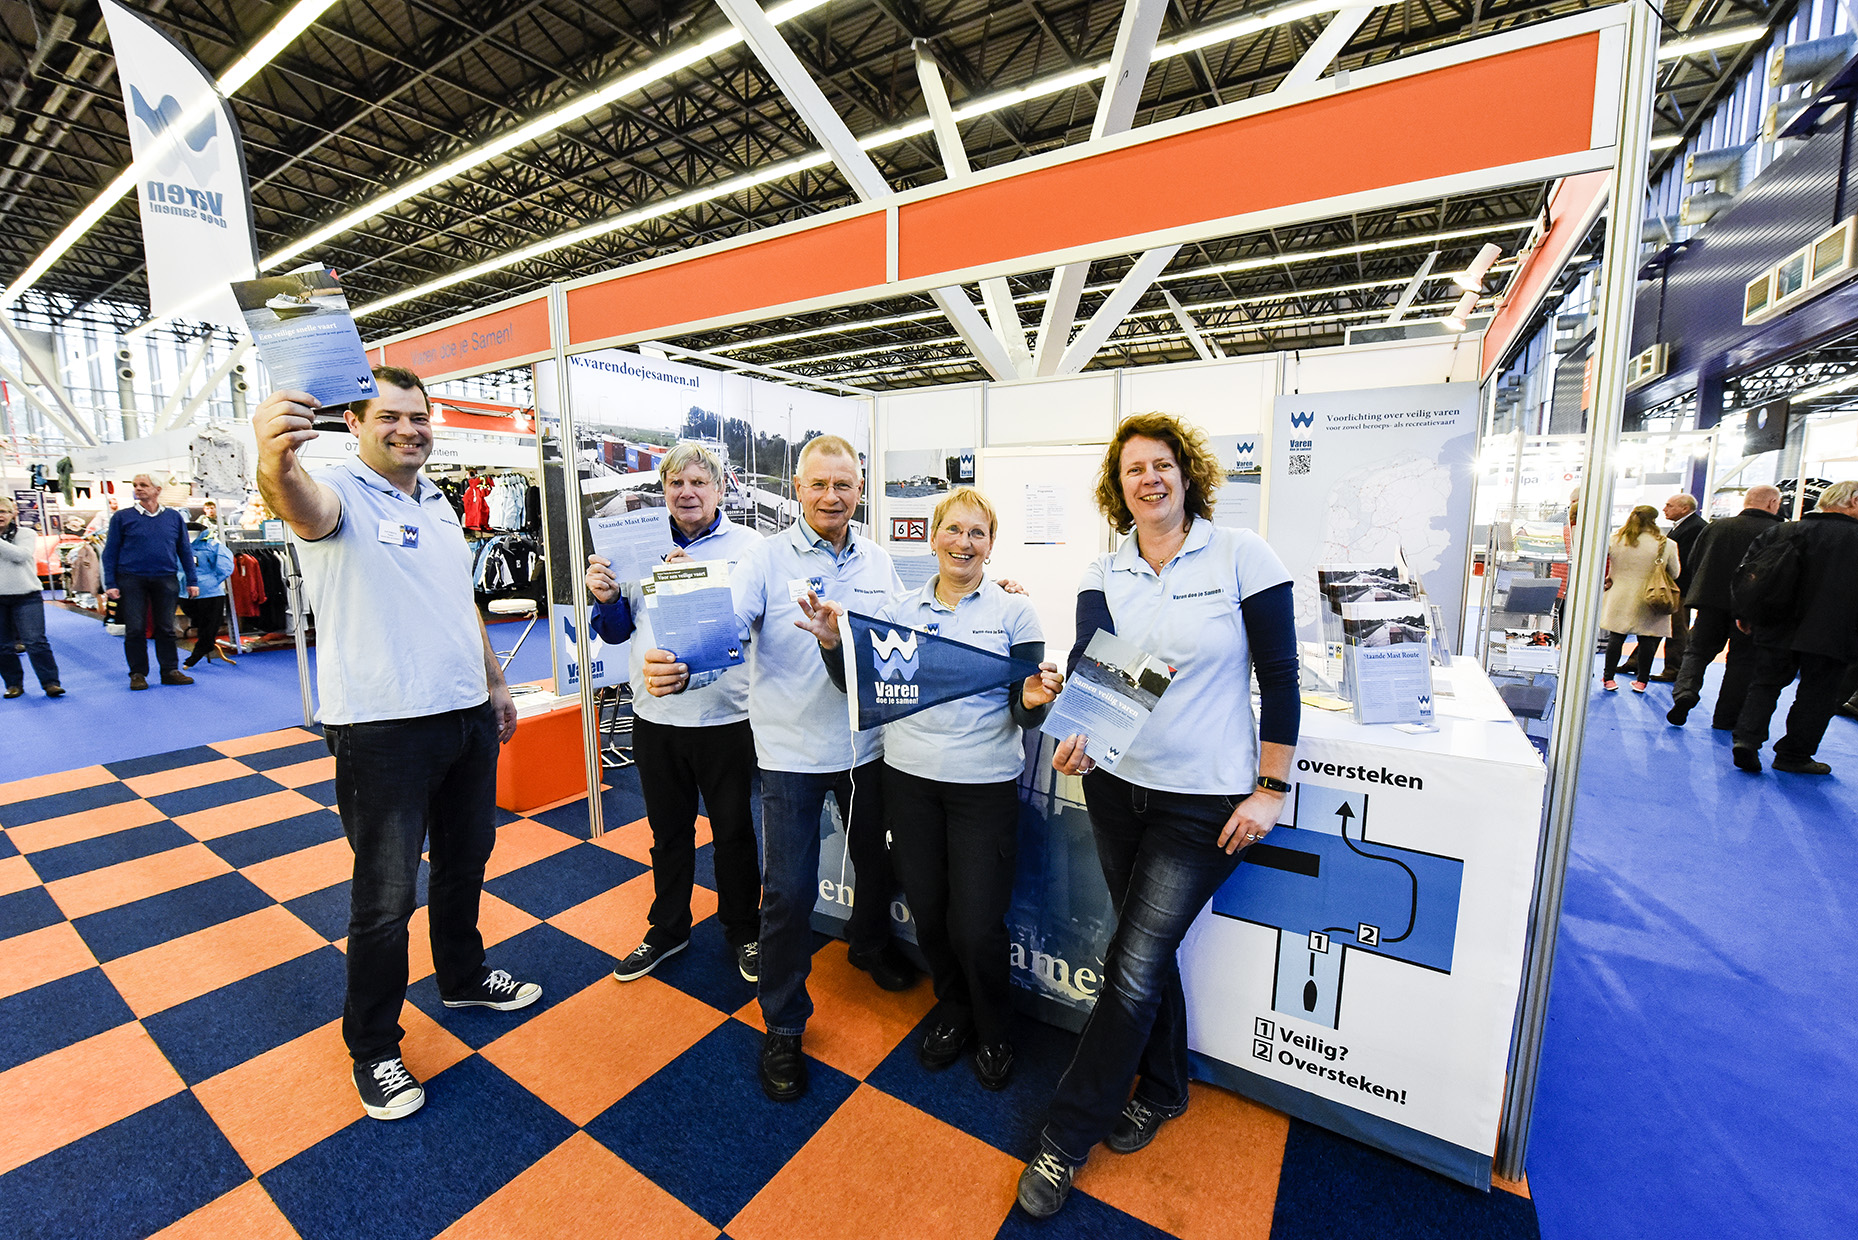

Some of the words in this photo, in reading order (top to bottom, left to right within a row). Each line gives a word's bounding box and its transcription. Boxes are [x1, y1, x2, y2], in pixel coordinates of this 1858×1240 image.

[258, 333, 273, 341] Een
[273, 327, 296, 338] veilige
[296, 324, 317, 334] snelle
[317, 321, 338, 331] vaart
[411, 347, 437, 366] Varen
[440, 342, 457, 359] doe
[460, 338, 469, 358] je
[472, 322, 513, 352] Samen!
[1326, 411, 1382, 422] Voorlichting
[1384, 412, 1404, 420] over
[1405, 409, 1432, 420] veilig
[1433, 409, 1461, 417] varen
[1393, 421, 1404, 429] als
[1405, 419, 1456, 429] recreatievaart
[1289, 439, 1313, 448] Varen
[1510, 475, 1539, 486] lpa
[598, 520, 623, 529] Staande
[624, 518, 640, 526] Mast
[641, 515, 660, 524] Route
[898, 524, 905, 535] 6
[567, 660, 604, 678] Ven
[874, 682, 919, 697] Varen
[1072, 676, 1097, 693] Samen
[1098, 689, 1118, 706] veilig
[1118, 701, 1140, 717] varen
[875, 696, 888, 705] doe
[888, 697, 895, 705] je
[895, 697, 919, 705] samen!
[1297, 759, 1424, 791] oversteken
[1314, 935, 1323, 950] 1
[1361, 927, 1375, 944] 2
[1260, 1022, 1269, 1036] 1
[1279, 1026, 1349, 1062] Veilig?
[1256, 1043, 1269, 1059] 2
[1278, 1050, 1407, 1106] Oversteken!
